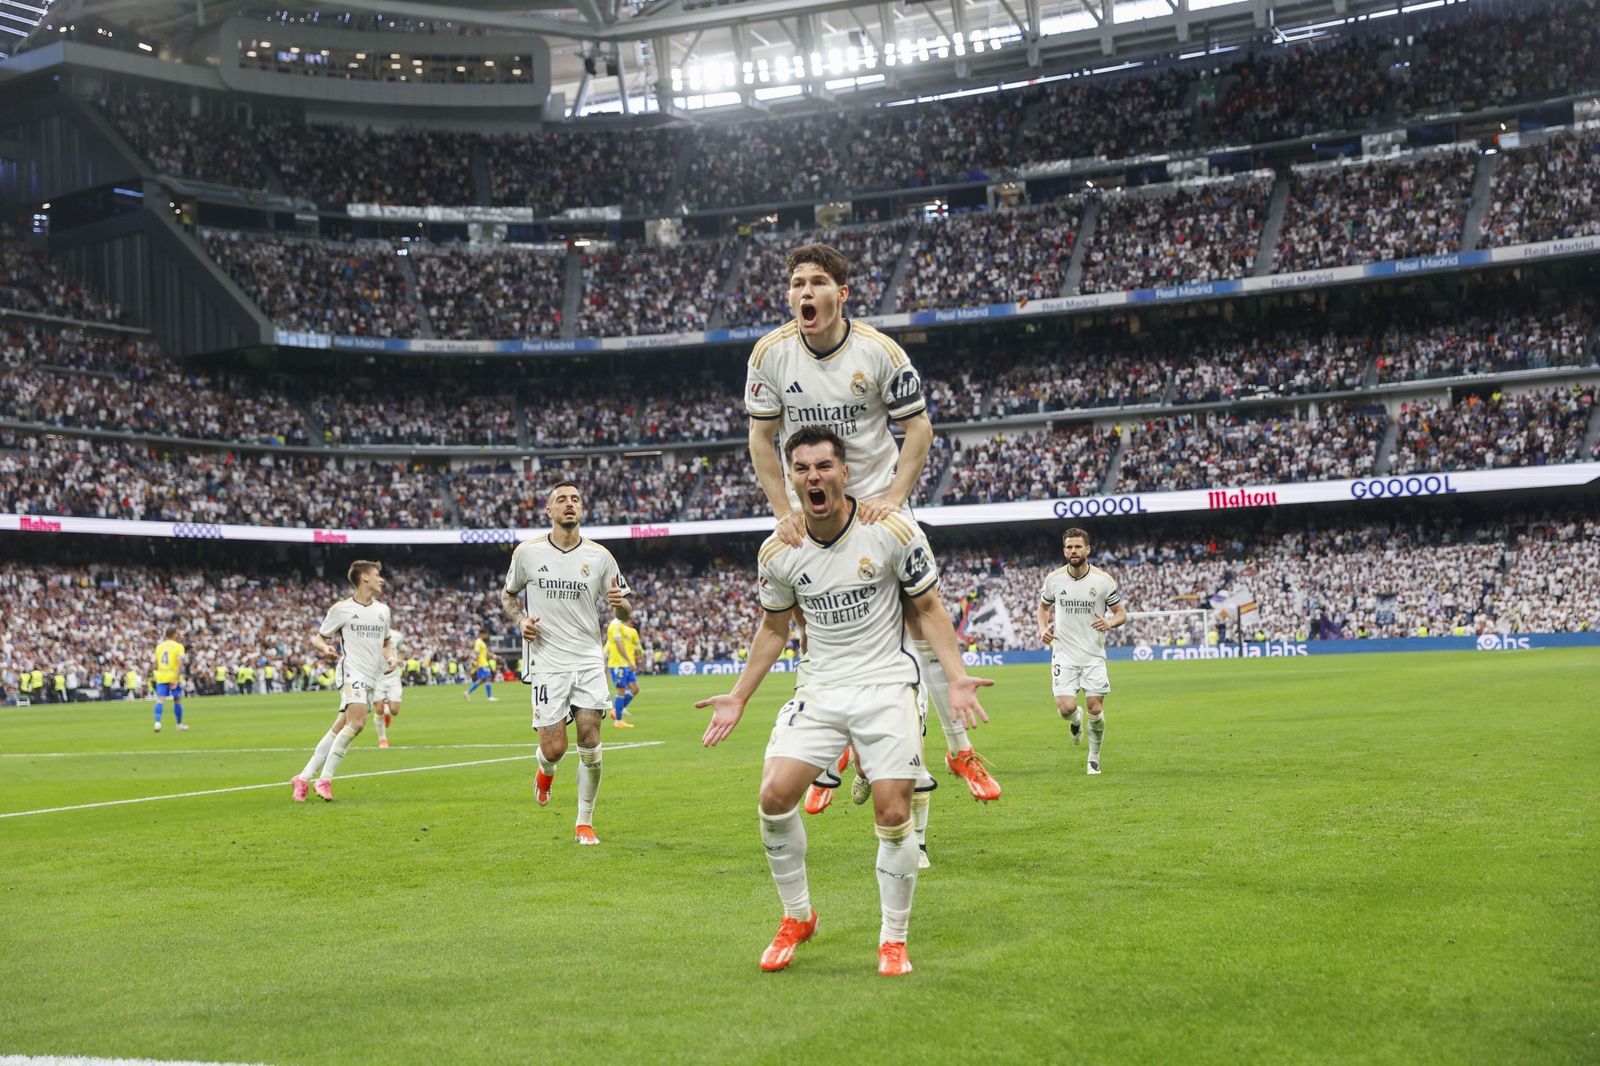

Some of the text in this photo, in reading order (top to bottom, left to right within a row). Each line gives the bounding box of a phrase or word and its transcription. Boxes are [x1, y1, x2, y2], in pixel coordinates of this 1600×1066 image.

[1524, 240, 1594, 257] Real Madrid
[1395, 256, 1459, 272] Real Madrid
[1271, 273, 1334, 288] Real Madrid
[1155, 284, 1213, 299] Real Madrid
[1042, 298, 1099, 312] Real Madrid
[936, 307, 989, 321] Real Madrid
[523, 340, 575, 351] Real Madrid
[787, 403, 868, 422] Emirates
[1351, 475, 1457, 499] GOOOOL
[1208, 489, 1277, 509] Mahou
[1053, 496, 1148, 519] GOOOOL
[538, 577, 588, 591] Emirates
[546, 590, 581, 600] FLY BETTER
[803, 583, 878, 610] Emirates
[1060, 598, 1096, 608] Emirates
[815, 601, 870, 625] FLY BETTER
[160, 651, 169, 666] 4
[534, 683, 549, 706] 14
